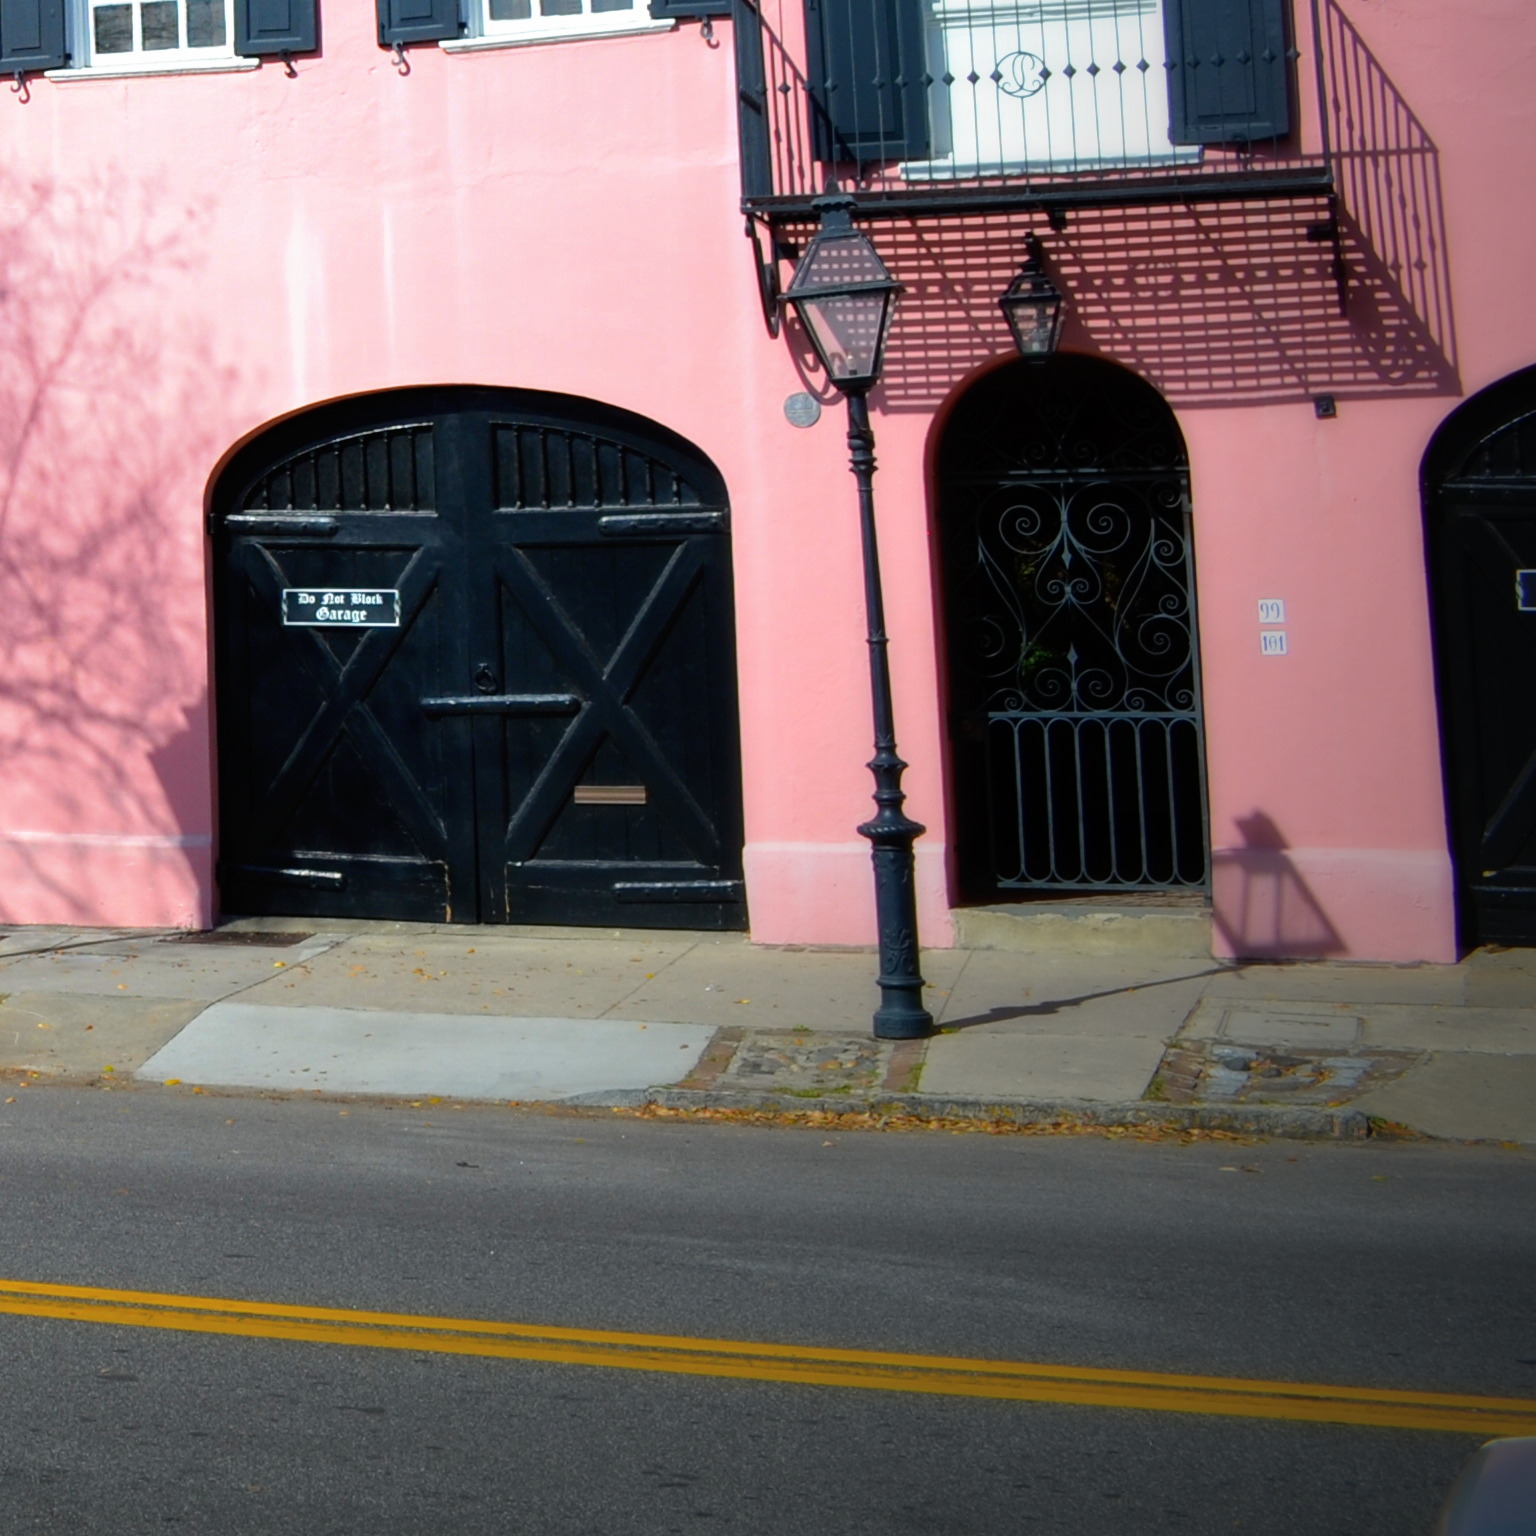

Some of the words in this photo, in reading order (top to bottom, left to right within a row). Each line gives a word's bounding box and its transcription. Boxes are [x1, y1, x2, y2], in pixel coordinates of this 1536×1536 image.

[298, 593, 316, 605] Do
[321, 593, 345, 605] Not
[350, 593, 384, 606] Block
[316, 606, 367, 623] Garage
[1260, 602, 1280, 619] 99
[1263, 636, 1283, 651] 101
